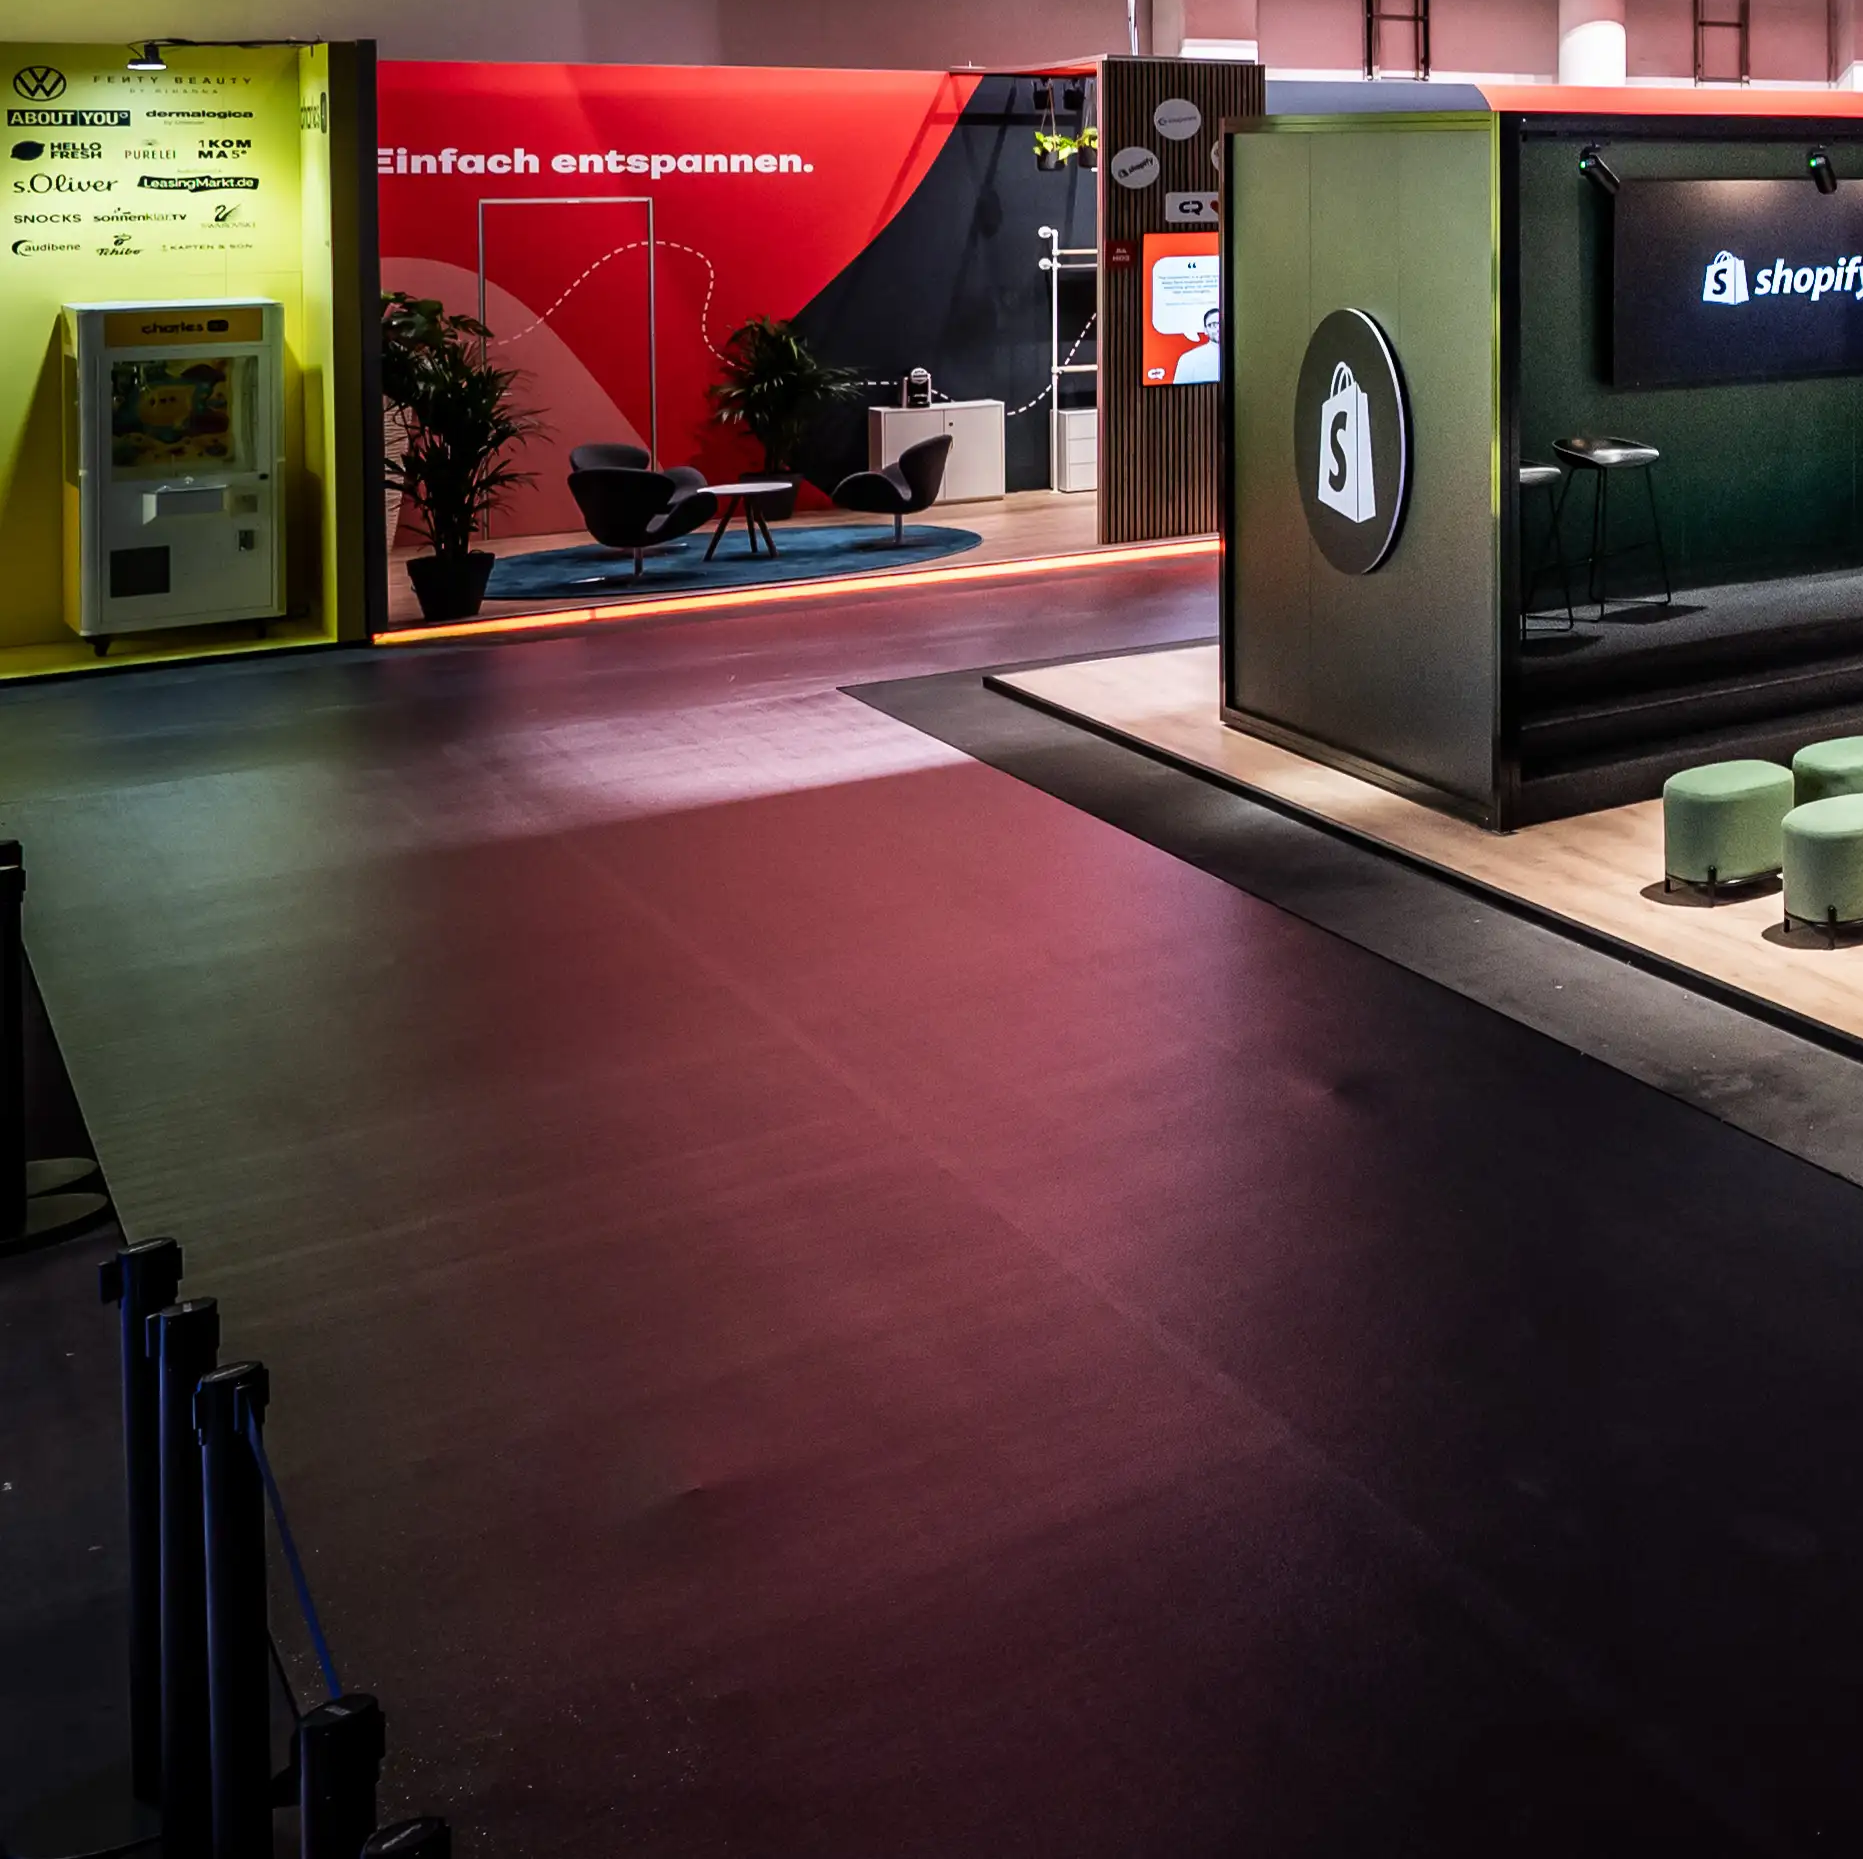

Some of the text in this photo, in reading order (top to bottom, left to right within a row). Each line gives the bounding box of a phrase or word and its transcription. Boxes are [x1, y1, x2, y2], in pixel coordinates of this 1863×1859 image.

[10, 111, 75, 125] ABOUT
[146, 110, 254, 119] dermalogica
[50, 142, 102, 151] HELLO
[50, 151, 102, 159] FRESH
[124, 150, 176, 160] PURELEI
[378, 147, 814, 179] Einfach entspannen.
[13, 173, 118, 194] s.Oliver
[143, 177, 254, 190] LeasingMarkt.de
[13, 213, 82, 224] SNOCKS
[24, 242, 81, 252] audibene
